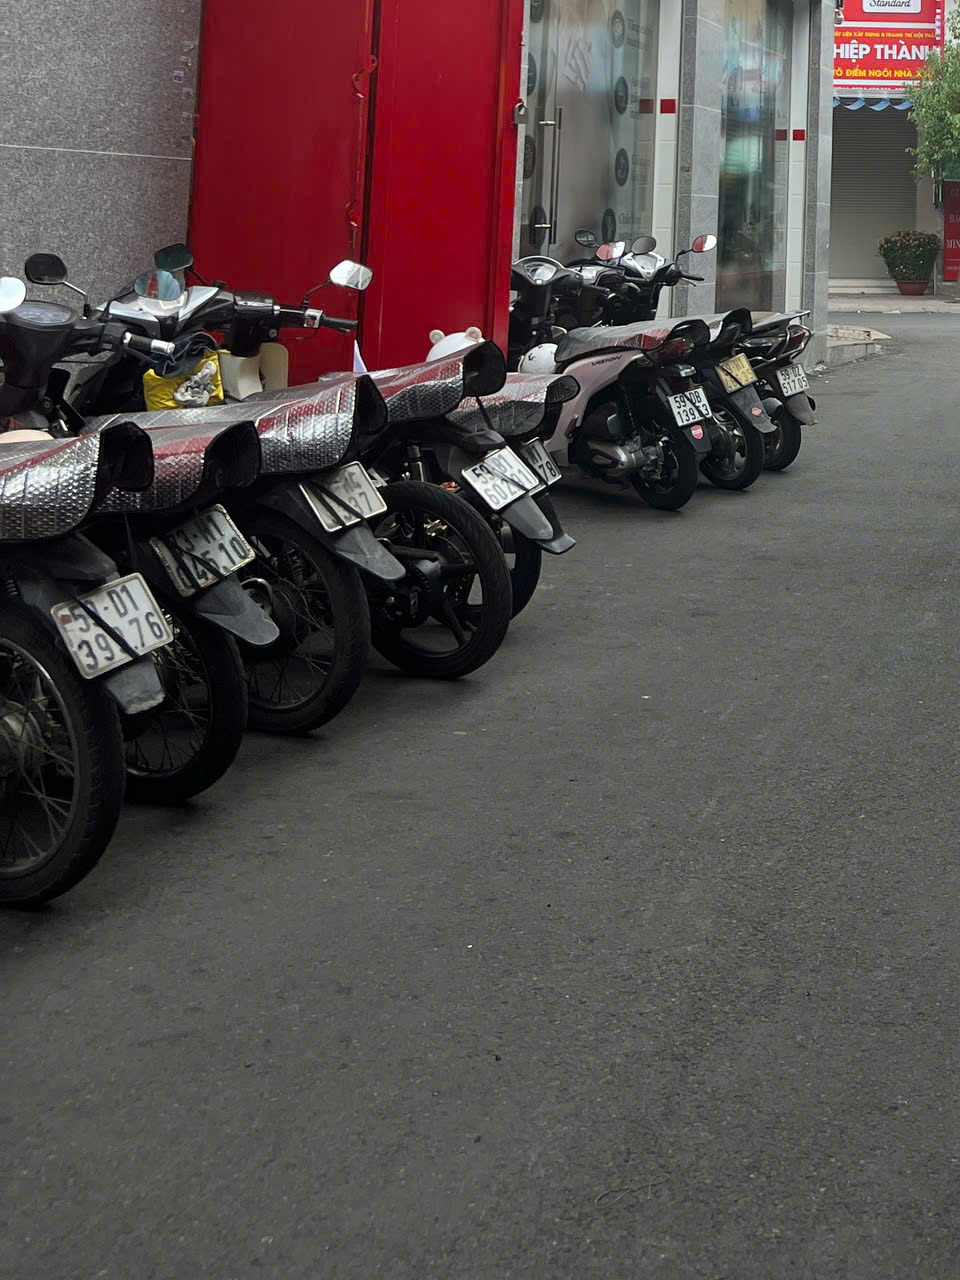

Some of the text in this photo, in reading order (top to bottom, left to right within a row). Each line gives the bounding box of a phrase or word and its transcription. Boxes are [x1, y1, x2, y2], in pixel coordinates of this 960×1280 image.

[833, 39, 871, 63] HIỆP
[845, 64, 866, 77] ĐIỂM
[868, 67, 892, 78] NGÔI
[894, 67, 913, 78] NHÀ
[673, 391, 702, 409] 59DB
[676, 403, 710, 423] 139.3
